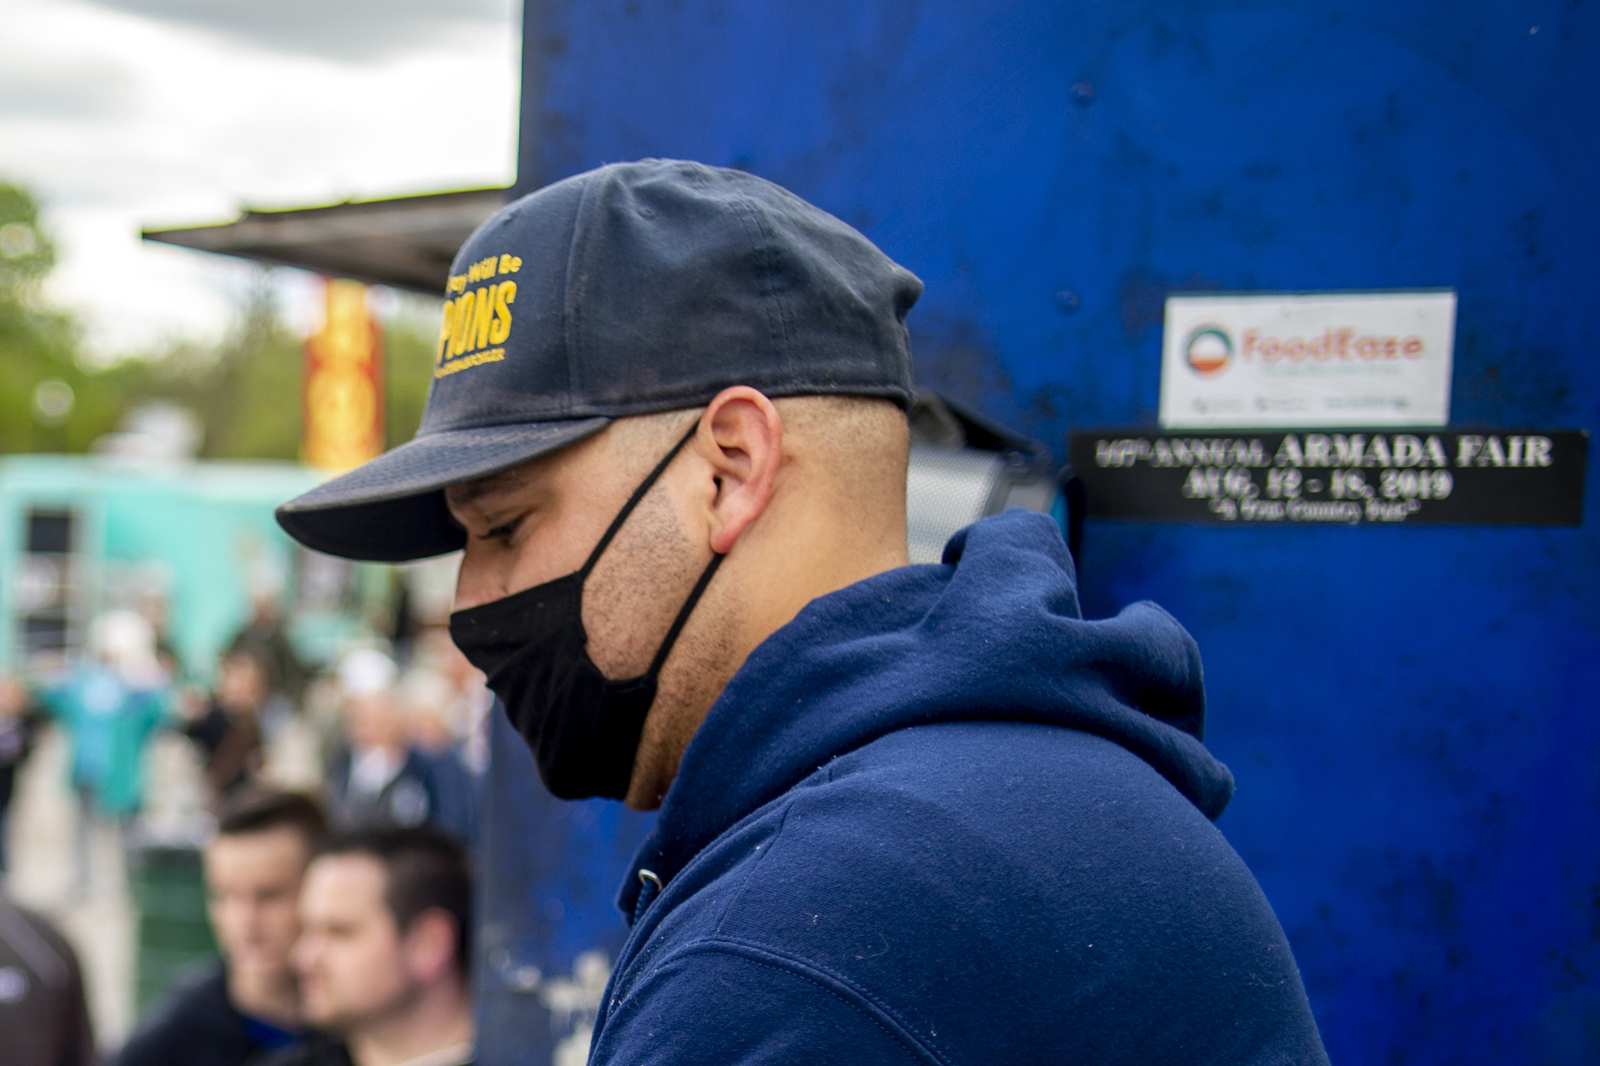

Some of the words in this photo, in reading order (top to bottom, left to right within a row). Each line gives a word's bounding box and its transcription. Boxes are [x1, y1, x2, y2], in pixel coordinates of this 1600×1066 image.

[499, 254, 522, 274] Be
[1151, 438, 1272, 468] ANNUAL
[1274, 432, 1448, 468] ARMADA
[1456, 434, 1554, 468] FAIR
[1183, 467, 1259, 499] AUG.
[1266, 467, 1302, 499] 12
[1379, 467, 1453, 500] 2019
[1286, 497, 1362, 525] Country
